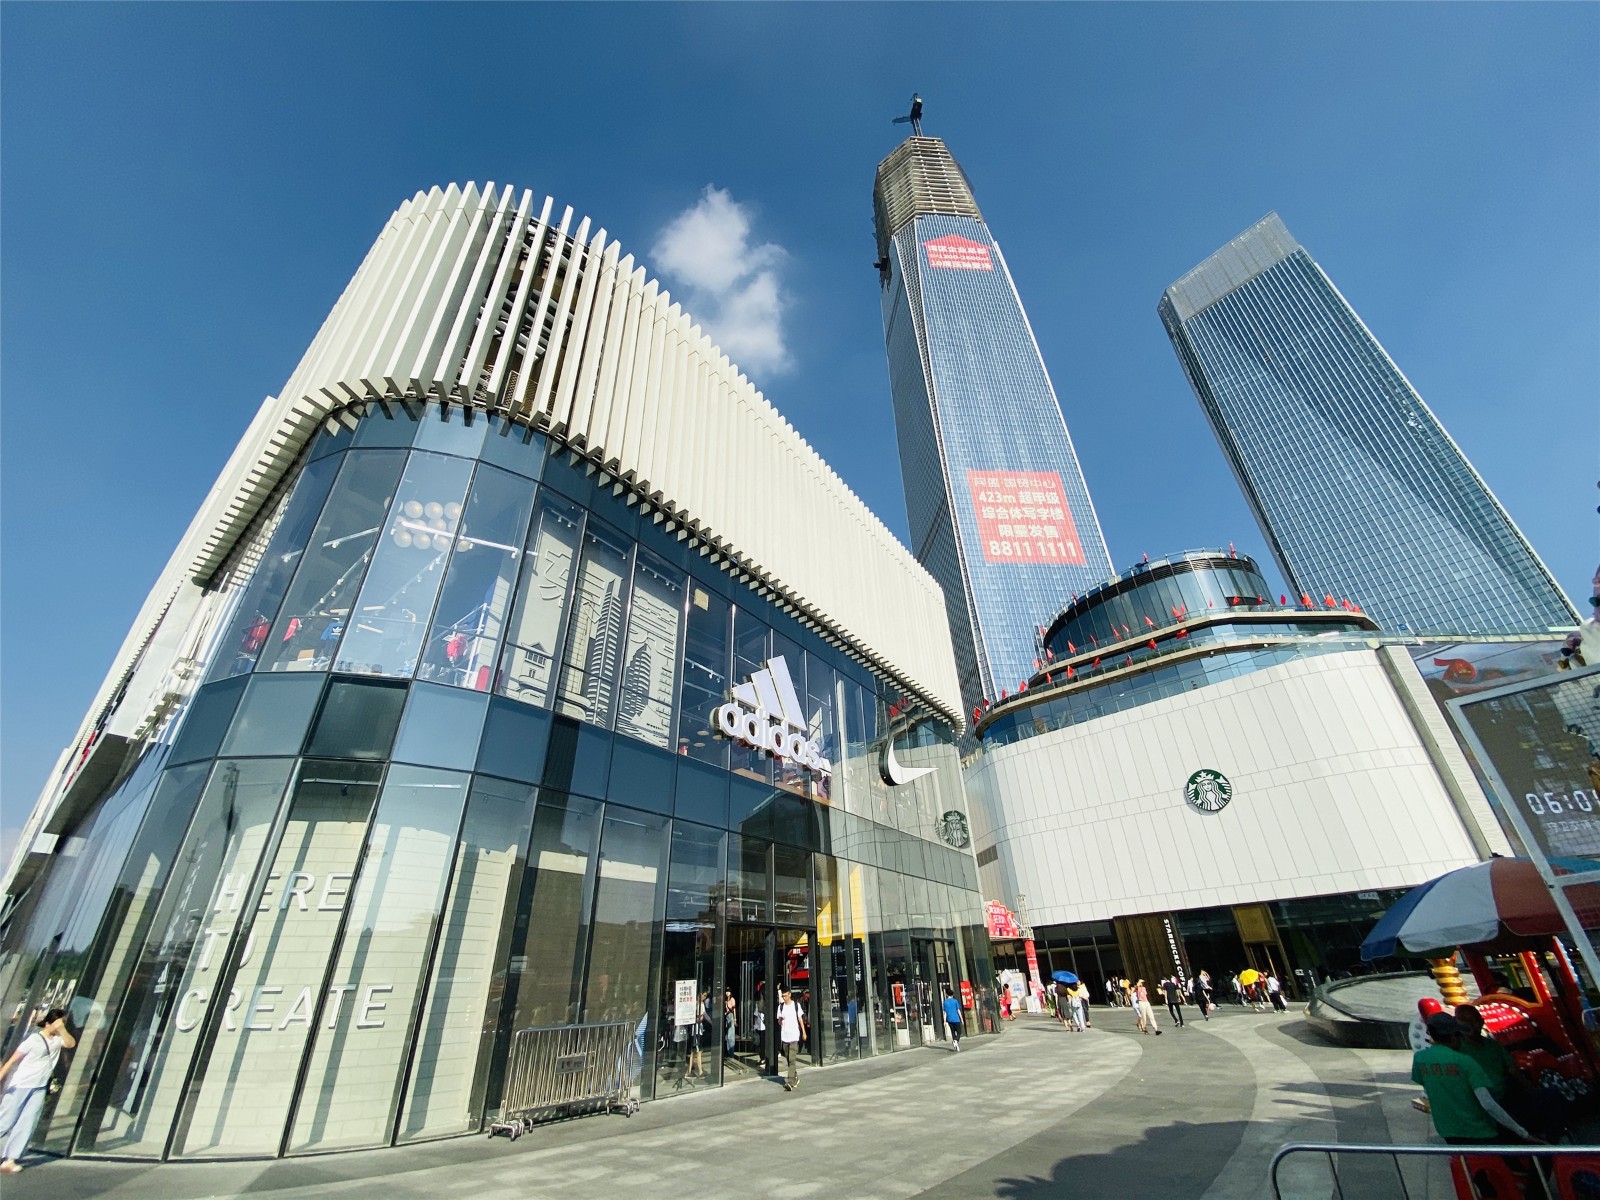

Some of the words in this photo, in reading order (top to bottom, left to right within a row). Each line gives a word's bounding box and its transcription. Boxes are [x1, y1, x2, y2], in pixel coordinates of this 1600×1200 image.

[979, 491, 1016, 503] 423m
[1018, 490, 1060, 504] 超甲级
[981, 506, 1064, 521] 综合体写字楼
[997, 524, 1059, 539] 限量发售
[989, 540, 1032, 556] 8811
[1036, 539, 1076, 557] 1111
[717, 702, 821, 771] adidas
[213, 870, 352, 912] HERE
[1163, 918, 1181, 965] STARBUCKS
[175, 983, 394, 1033] CREATE
